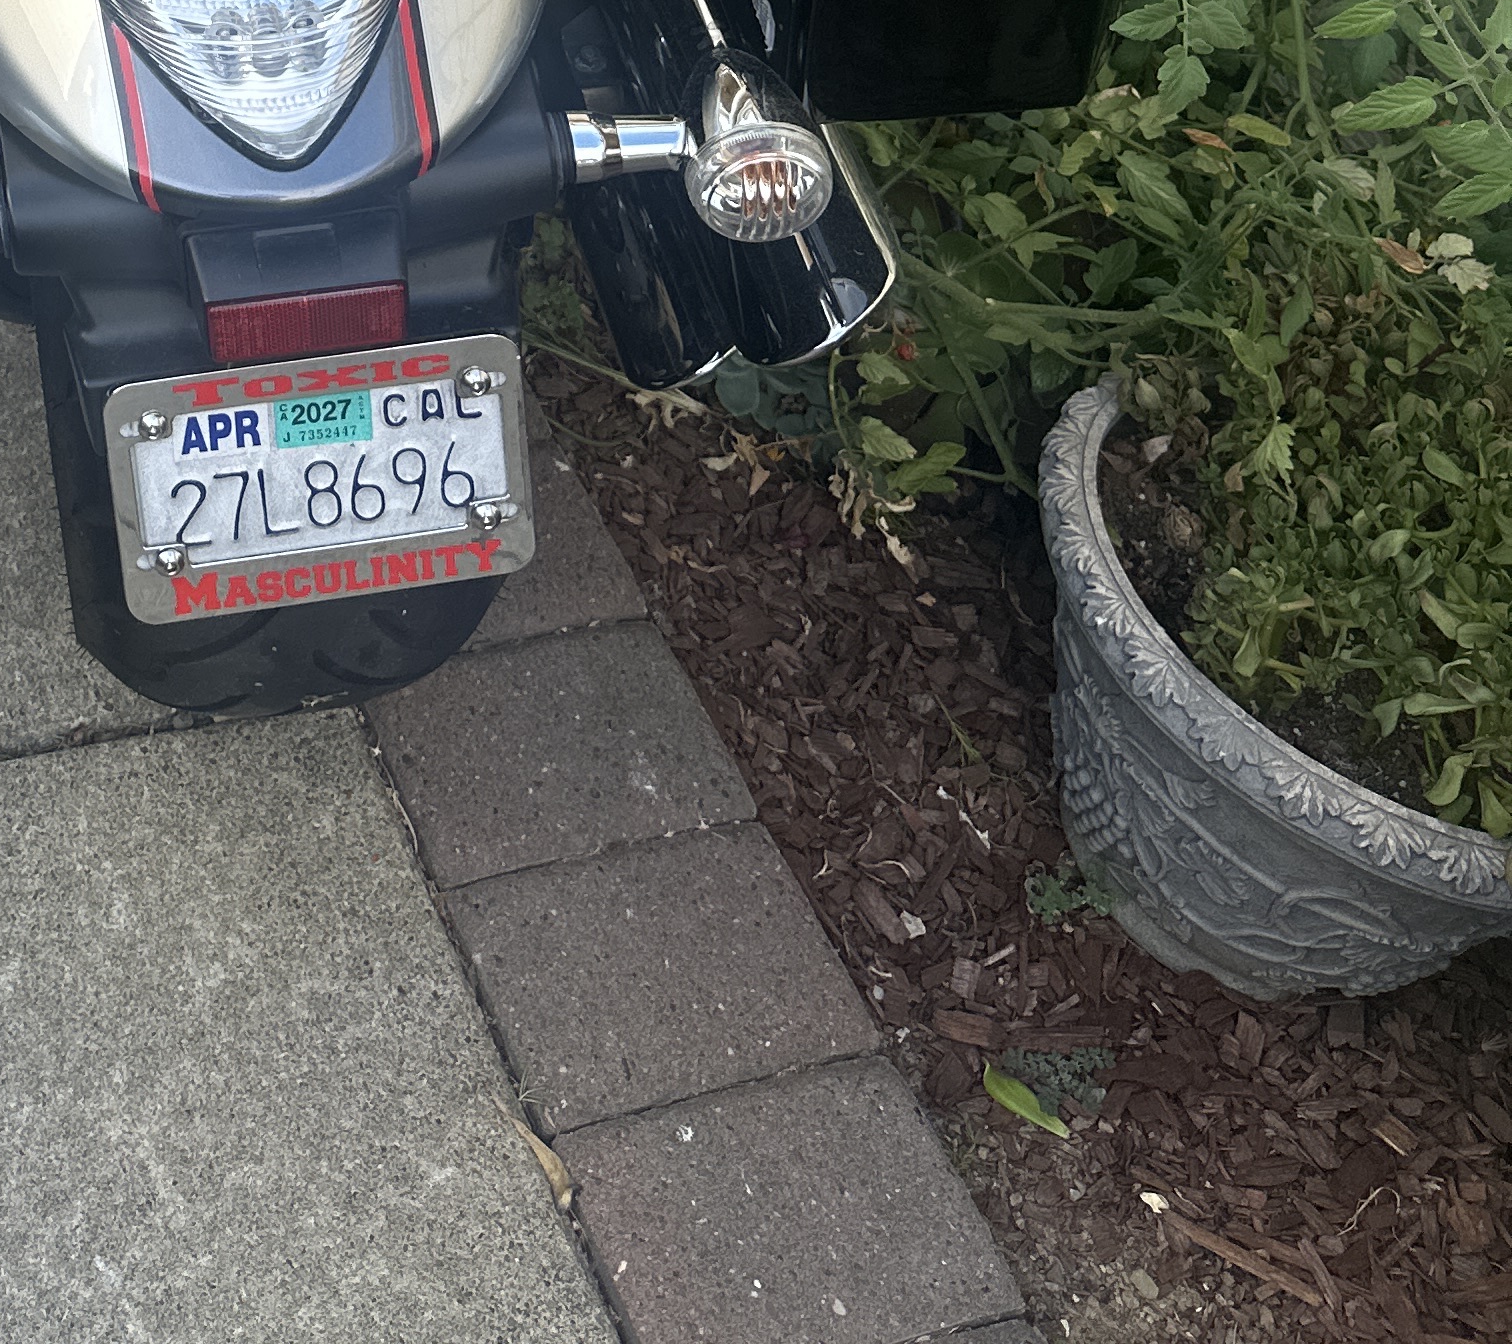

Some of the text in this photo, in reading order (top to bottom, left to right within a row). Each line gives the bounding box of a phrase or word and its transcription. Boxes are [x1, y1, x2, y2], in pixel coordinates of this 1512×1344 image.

[173, 354, 450, 406] TOXIC
[279, 403, 288, 421] CA
[291, 398, 351, 425] 2027
[383, 388, 482, 427] CAL
[181, 410, 261, 455] APR
[283, 431, 291, 442] J
[171, 441, 475, 546] 27L8696
[171, 539, 501, 616] MASCULINITY
